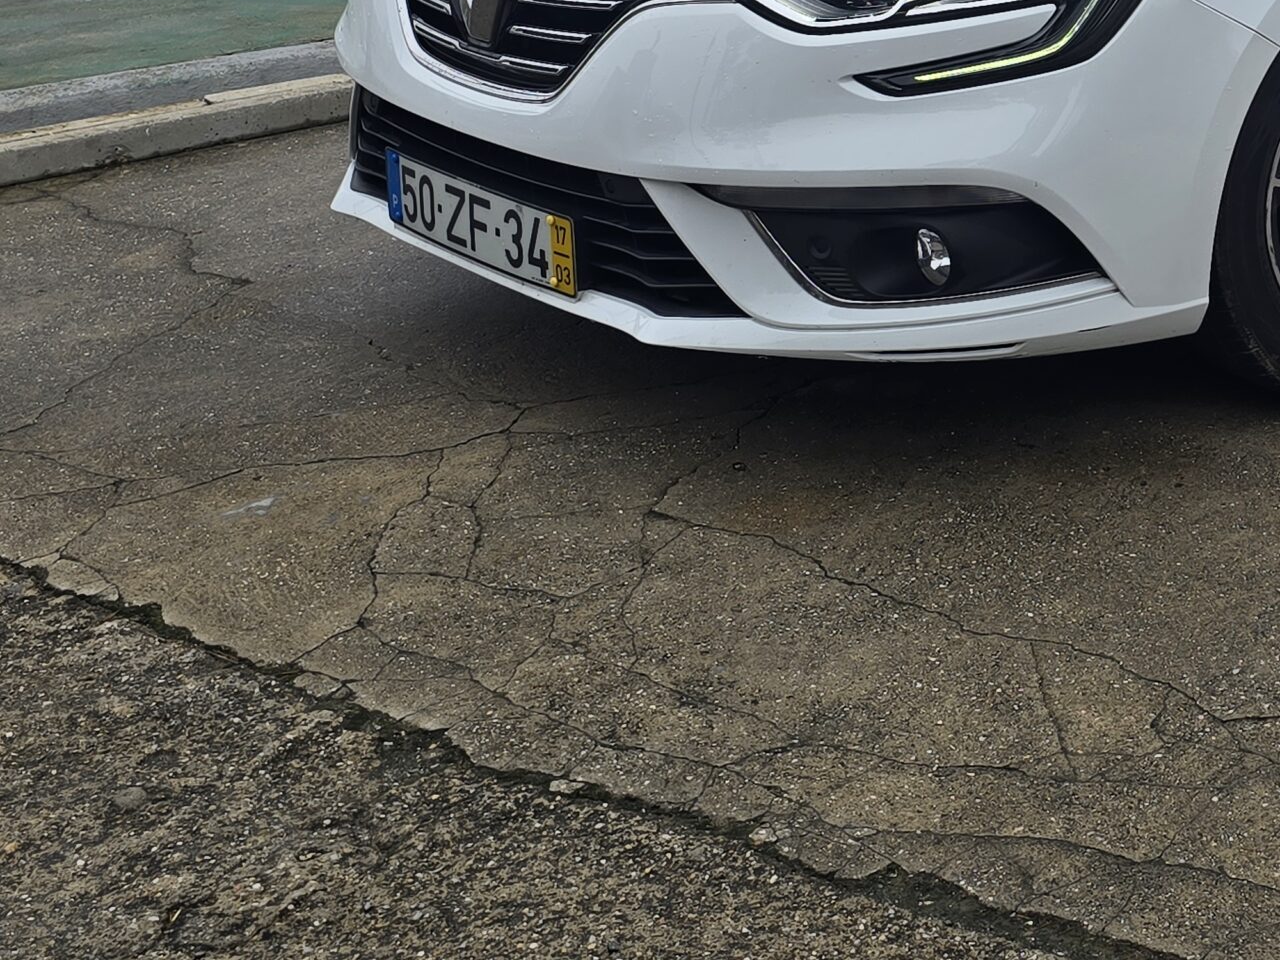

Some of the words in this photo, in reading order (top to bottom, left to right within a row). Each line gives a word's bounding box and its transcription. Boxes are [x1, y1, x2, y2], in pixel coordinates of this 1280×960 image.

[392, 193, 399, 208] P
[554, 225, 566, 246] 17
[555, 263, 571, 286] 03
